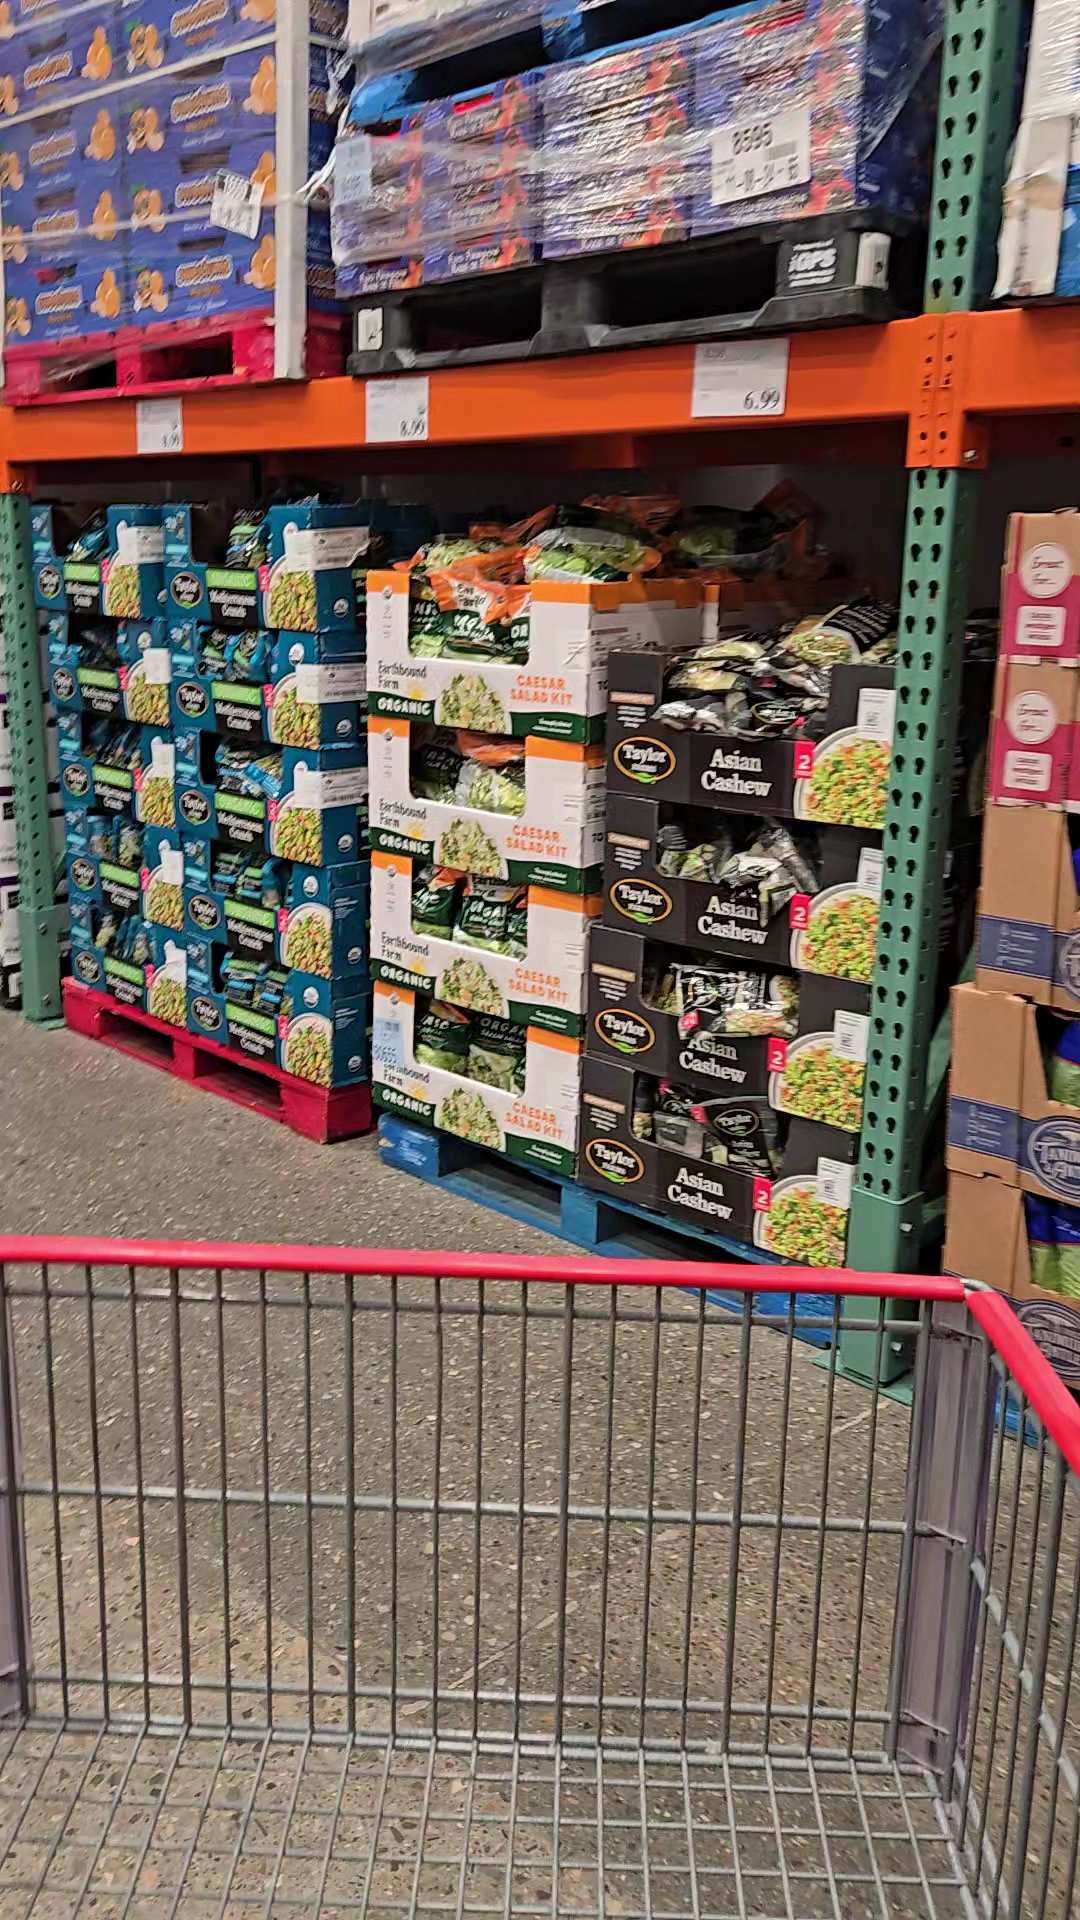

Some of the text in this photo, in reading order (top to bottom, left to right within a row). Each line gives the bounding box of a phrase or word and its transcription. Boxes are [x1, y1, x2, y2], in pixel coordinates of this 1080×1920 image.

[743, 389, 780, 410] 6.99
[378, 676, 399, 689] Farm
[517, 674, 566, 690] CAESAR
[377, 697, 431, 716] ORGANIC
[509, 688, 574, 706] SALAD KIT
[622, 744, 667, 764] Taylor
[709, 748, 762, 772] Asian
[799, 756, 810, 769] 2
[701, 770, 772, 796] Cashew
[380, 813, 400, 828] Farm
[512, 824, 561, 842] CAESAR
[379, 834, 430, 855] ORGANIC
[506, 837, 570, 858] SALAD KIT
[619, 884, 663, 905] Taylor
[705, 895, 758, 920] Asian
[794, 907, 806, 921] 2
[698, 916, 768, 944] Cashew
[381, 945, 401, 961] Farm
[380, 965, 431, 990] ORGANIC
[515, 967, 561, 987] CAESAR
[508, 979, 570, 1004] SALAD KIT
[603, 1014, 646, 1037] Taylor
[687, 1036, 738, 1060] Asian
[771, 1051, 783, 1065] 2
[679, 1051, 747, 1083] Cashew
[384, 1072, 403, 1087] Farm
[382, 1088, 431, 1117] ORGANIC
[512, 1101, 557, 1124] CAESAR
[505, 1112, 565, 1140] SALAD KIT
[594, 1143, 636, 1168] Taylor
[675, 1167, 724, 1196] Asian
[667, 1184, 733, 1219] Cashew
[757, 1190, 768, 1205] 2
